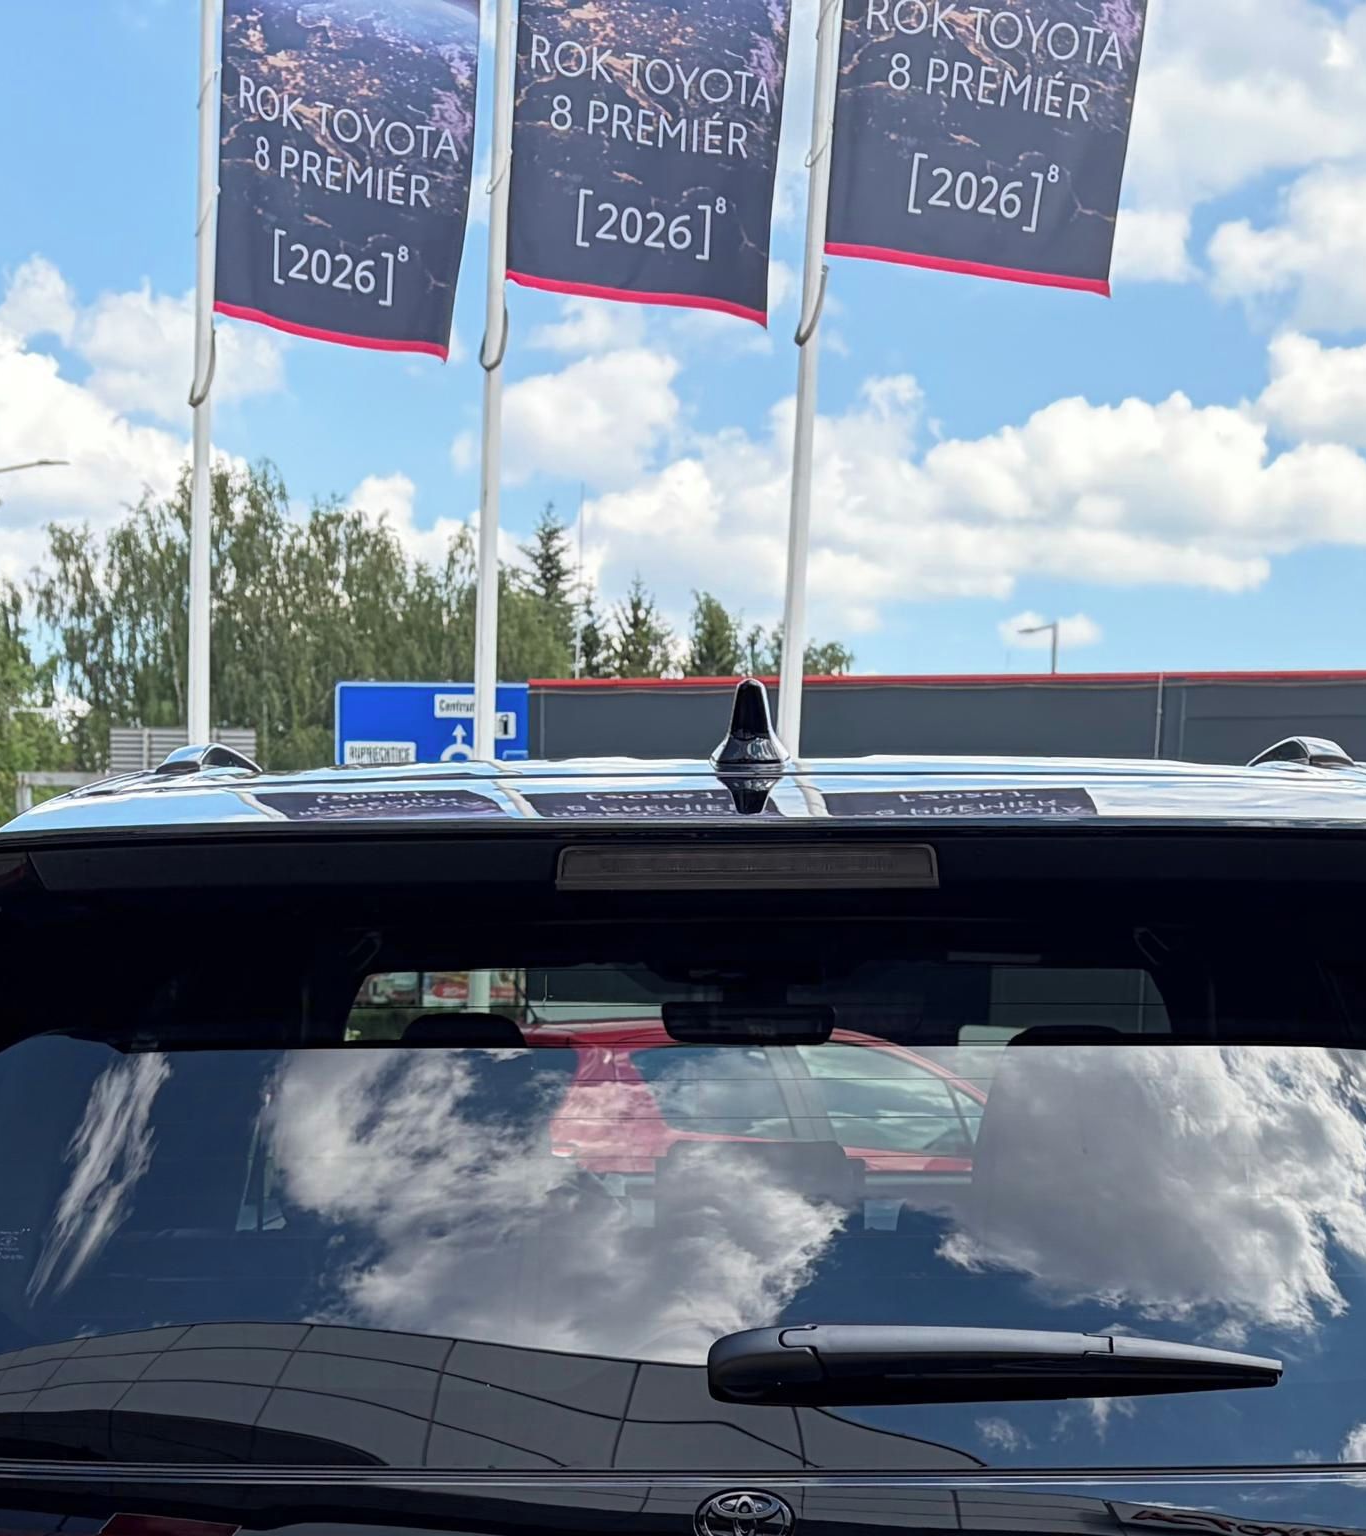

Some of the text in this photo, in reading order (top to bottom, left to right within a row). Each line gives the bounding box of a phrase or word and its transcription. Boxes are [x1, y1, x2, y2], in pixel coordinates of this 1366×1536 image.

[866, 0, 1124, 71] ROK TOYOTA
[530, 34, 772, 114] ROK TOYOTA
[887, 52, 1090, 122] 8 PREMIÉR
[239, 75, 460, 162] ROK TOYOTA
[550, 94, 748, 159] 8 PREMIÉR
[254, 136, 431, 208] 8 PREMIÉR
[439, 699, 475, 713] Centru
